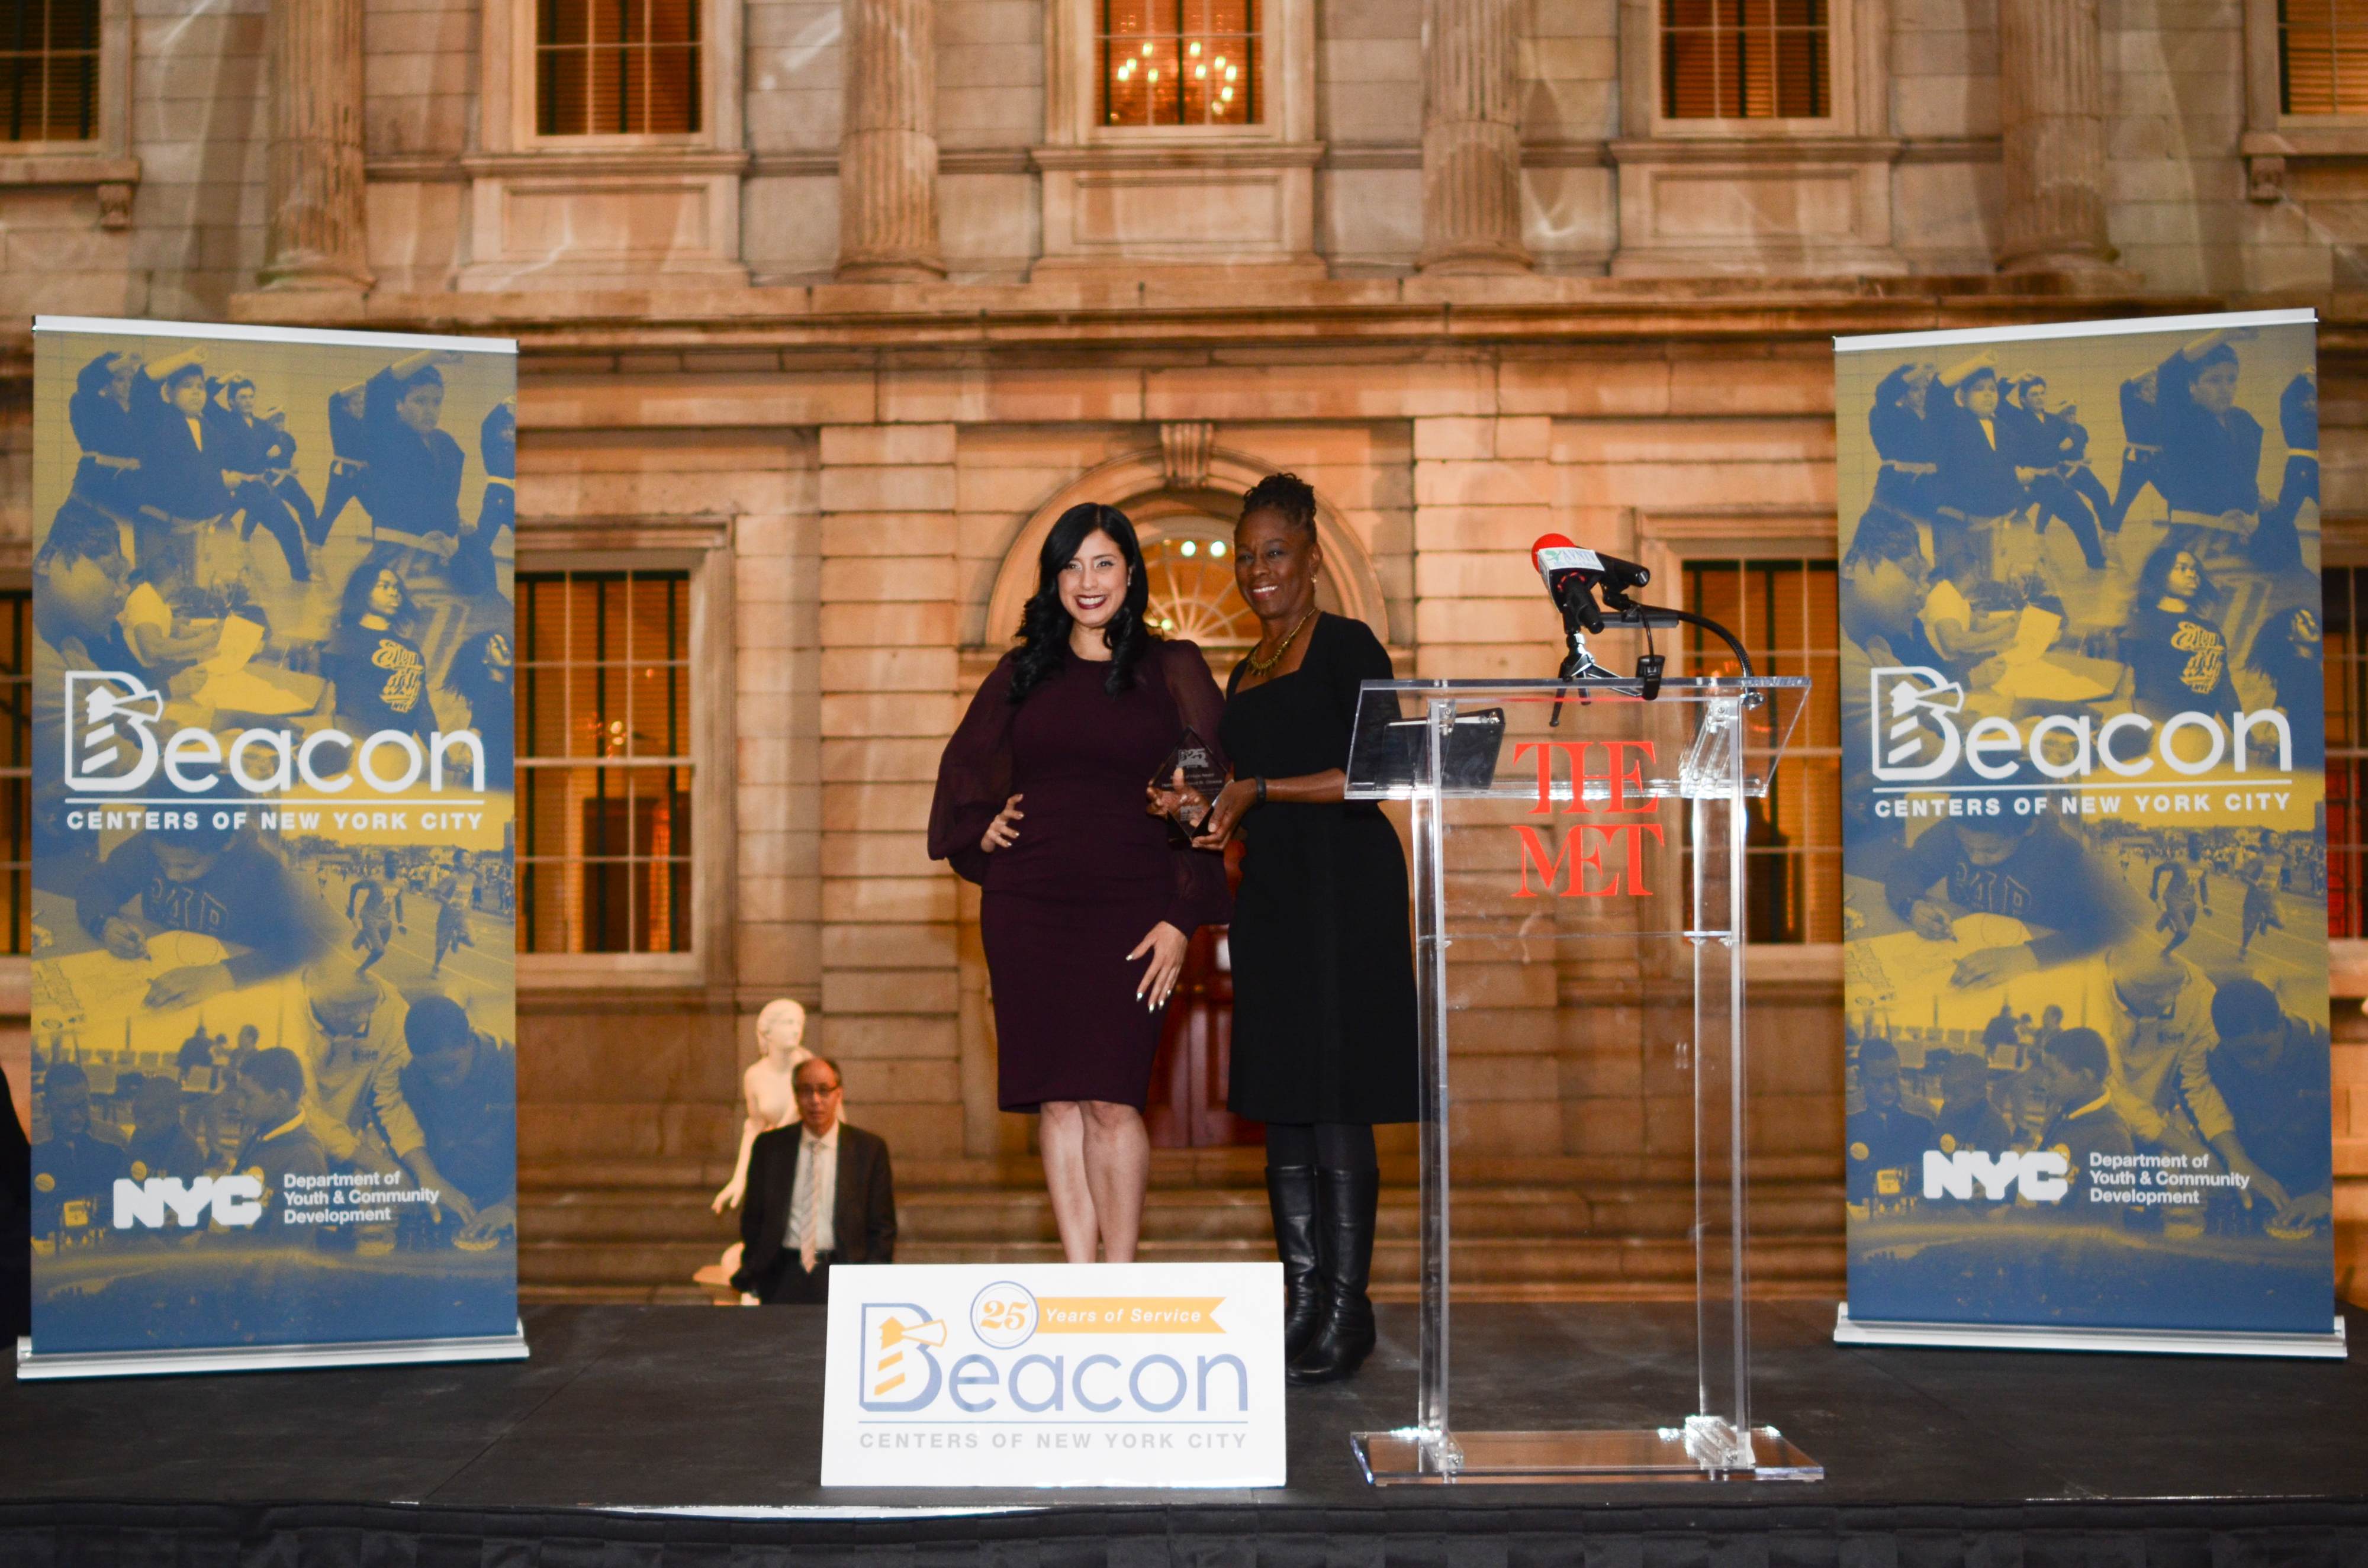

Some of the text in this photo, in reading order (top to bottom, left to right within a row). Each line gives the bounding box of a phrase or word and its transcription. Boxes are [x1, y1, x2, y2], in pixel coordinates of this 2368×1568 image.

[65, 670, 487, 793] Beacon
[1870, 665, 2293, 781] Beacon
[1513, 741, 1658, 814] THE
[1874, 793, 2290, 817] CENTERS OF NEW YORK CITY
[66, 811, 482, 830] CENTERS OF NEW YORK CITY
[1511, 823, 1665, 898] MET
[2090, 1152, 2209, 1170] Department of
[284, 1170, 401, 1190] Department of
[1923, 1150, 2068, 1202] NYC
[2090, 1170, 2250, 1189] Youth & Community
[113, 1174, 263, 1229] NYC
[284, 1186, 440, 1206] Youth & Community
[2090, 1187, 2200, 1205] Development
[284, 1206, 391, 1225] Development
[981, 1300, 1028, 1330] 25
[1046, 1308, 1201, 1323] Years of Service
[859, 1303, 1248, 1412] Beacon
[860, 1433, 1246, 1448] CENTERS OF NEW YORK CITY
